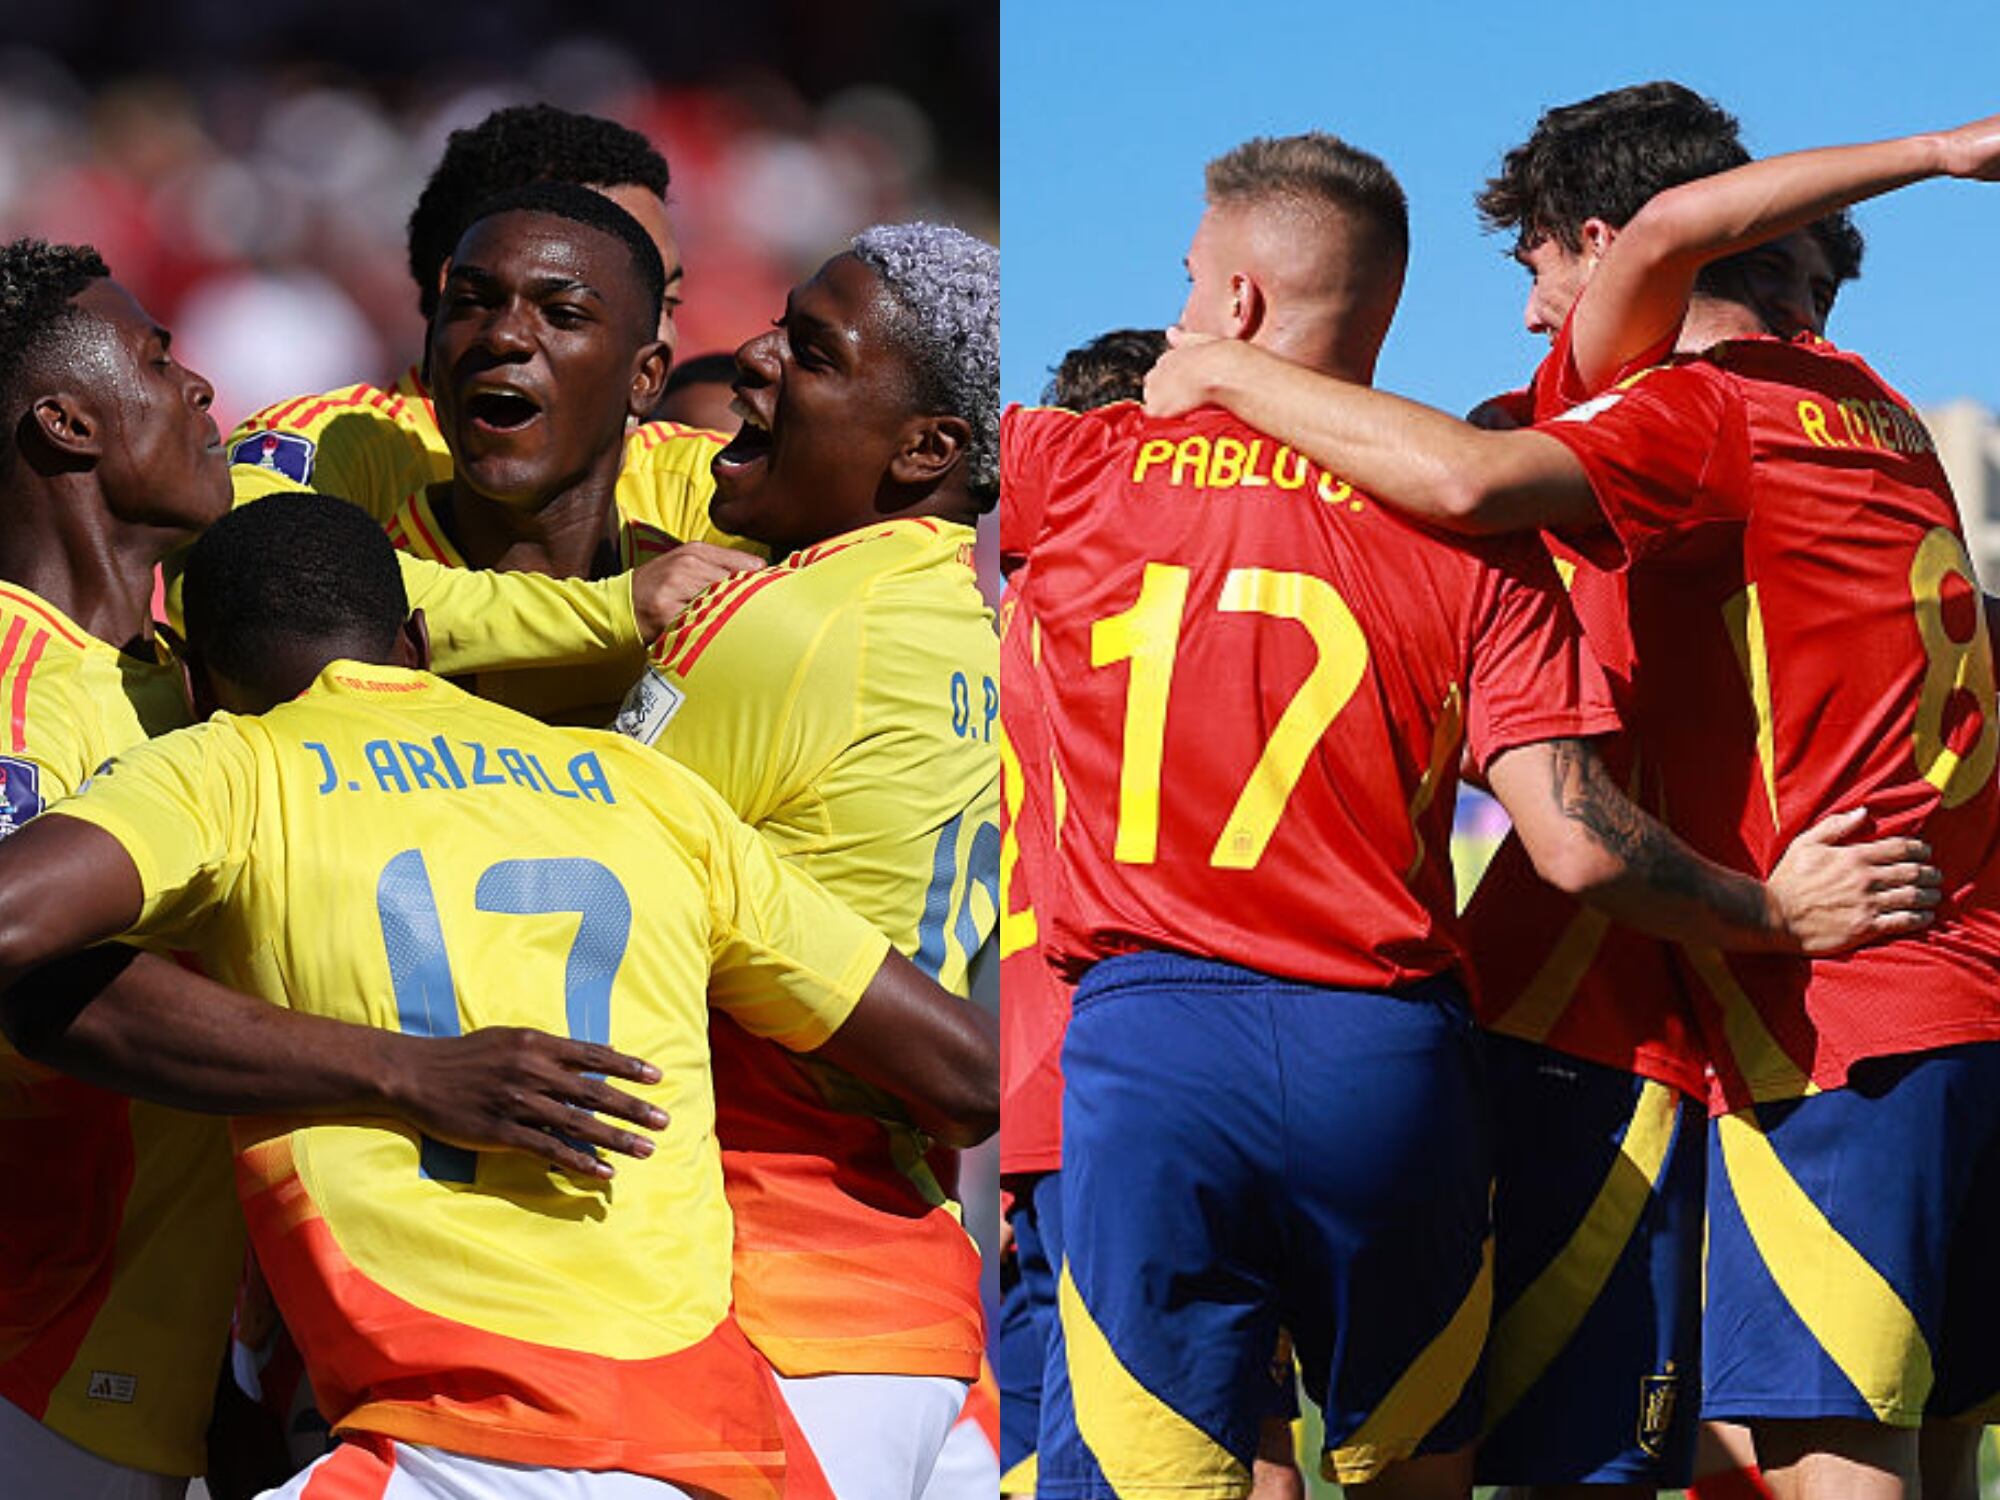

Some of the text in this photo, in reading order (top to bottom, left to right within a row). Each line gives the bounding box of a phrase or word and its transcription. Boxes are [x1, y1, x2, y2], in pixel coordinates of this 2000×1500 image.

[1132, 436, 1308, 490] PABLO
[364, 734, 617, 805] ARIZALA
[1091, 561, 1369, 870] 17
[1909, 527, 1999, 809] 8
[377, 848, 632, 1184] 17
